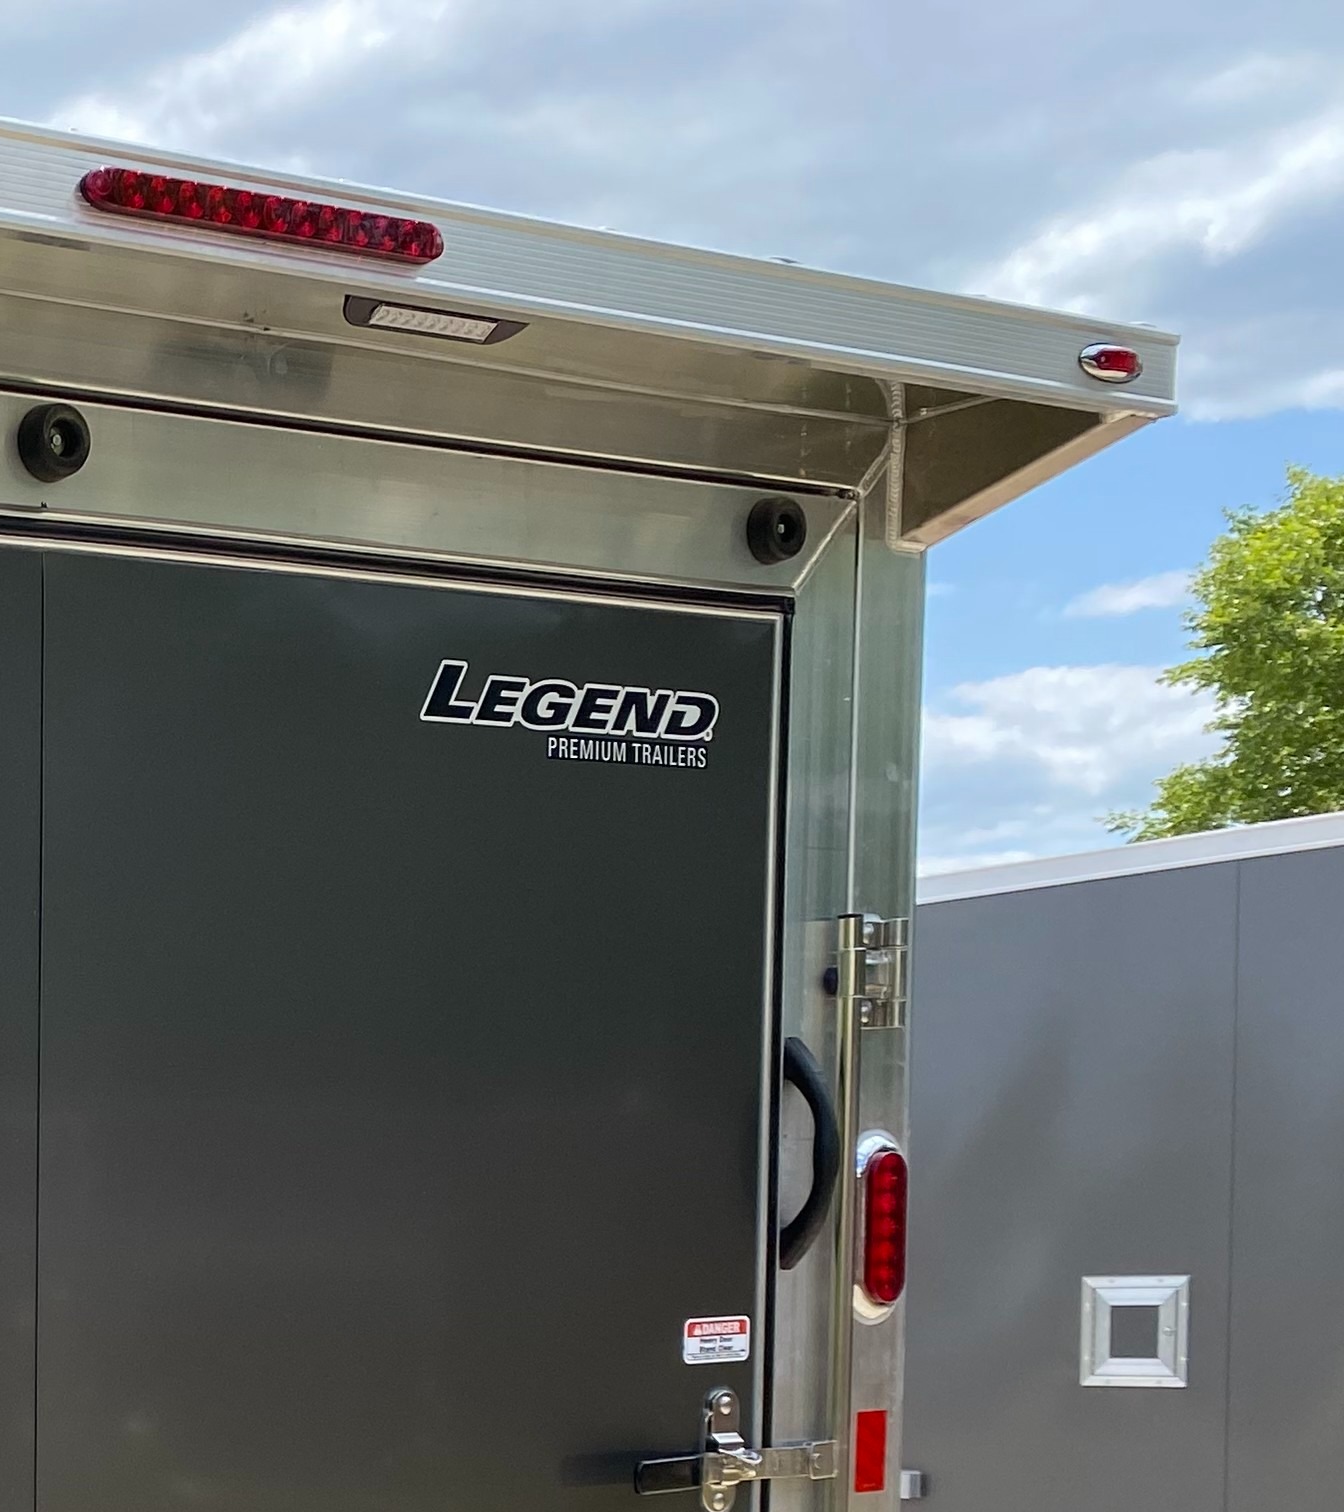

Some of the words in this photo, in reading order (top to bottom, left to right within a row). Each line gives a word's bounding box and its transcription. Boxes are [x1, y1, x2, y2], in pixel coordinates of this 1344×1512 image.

[420, 659, 719, 741] LEGEND
[548, 737, 627, 763] PREMIUM
[632, 744, 707, 768] TRAILERS
[702, 1322, 740, 1335] DANGER
